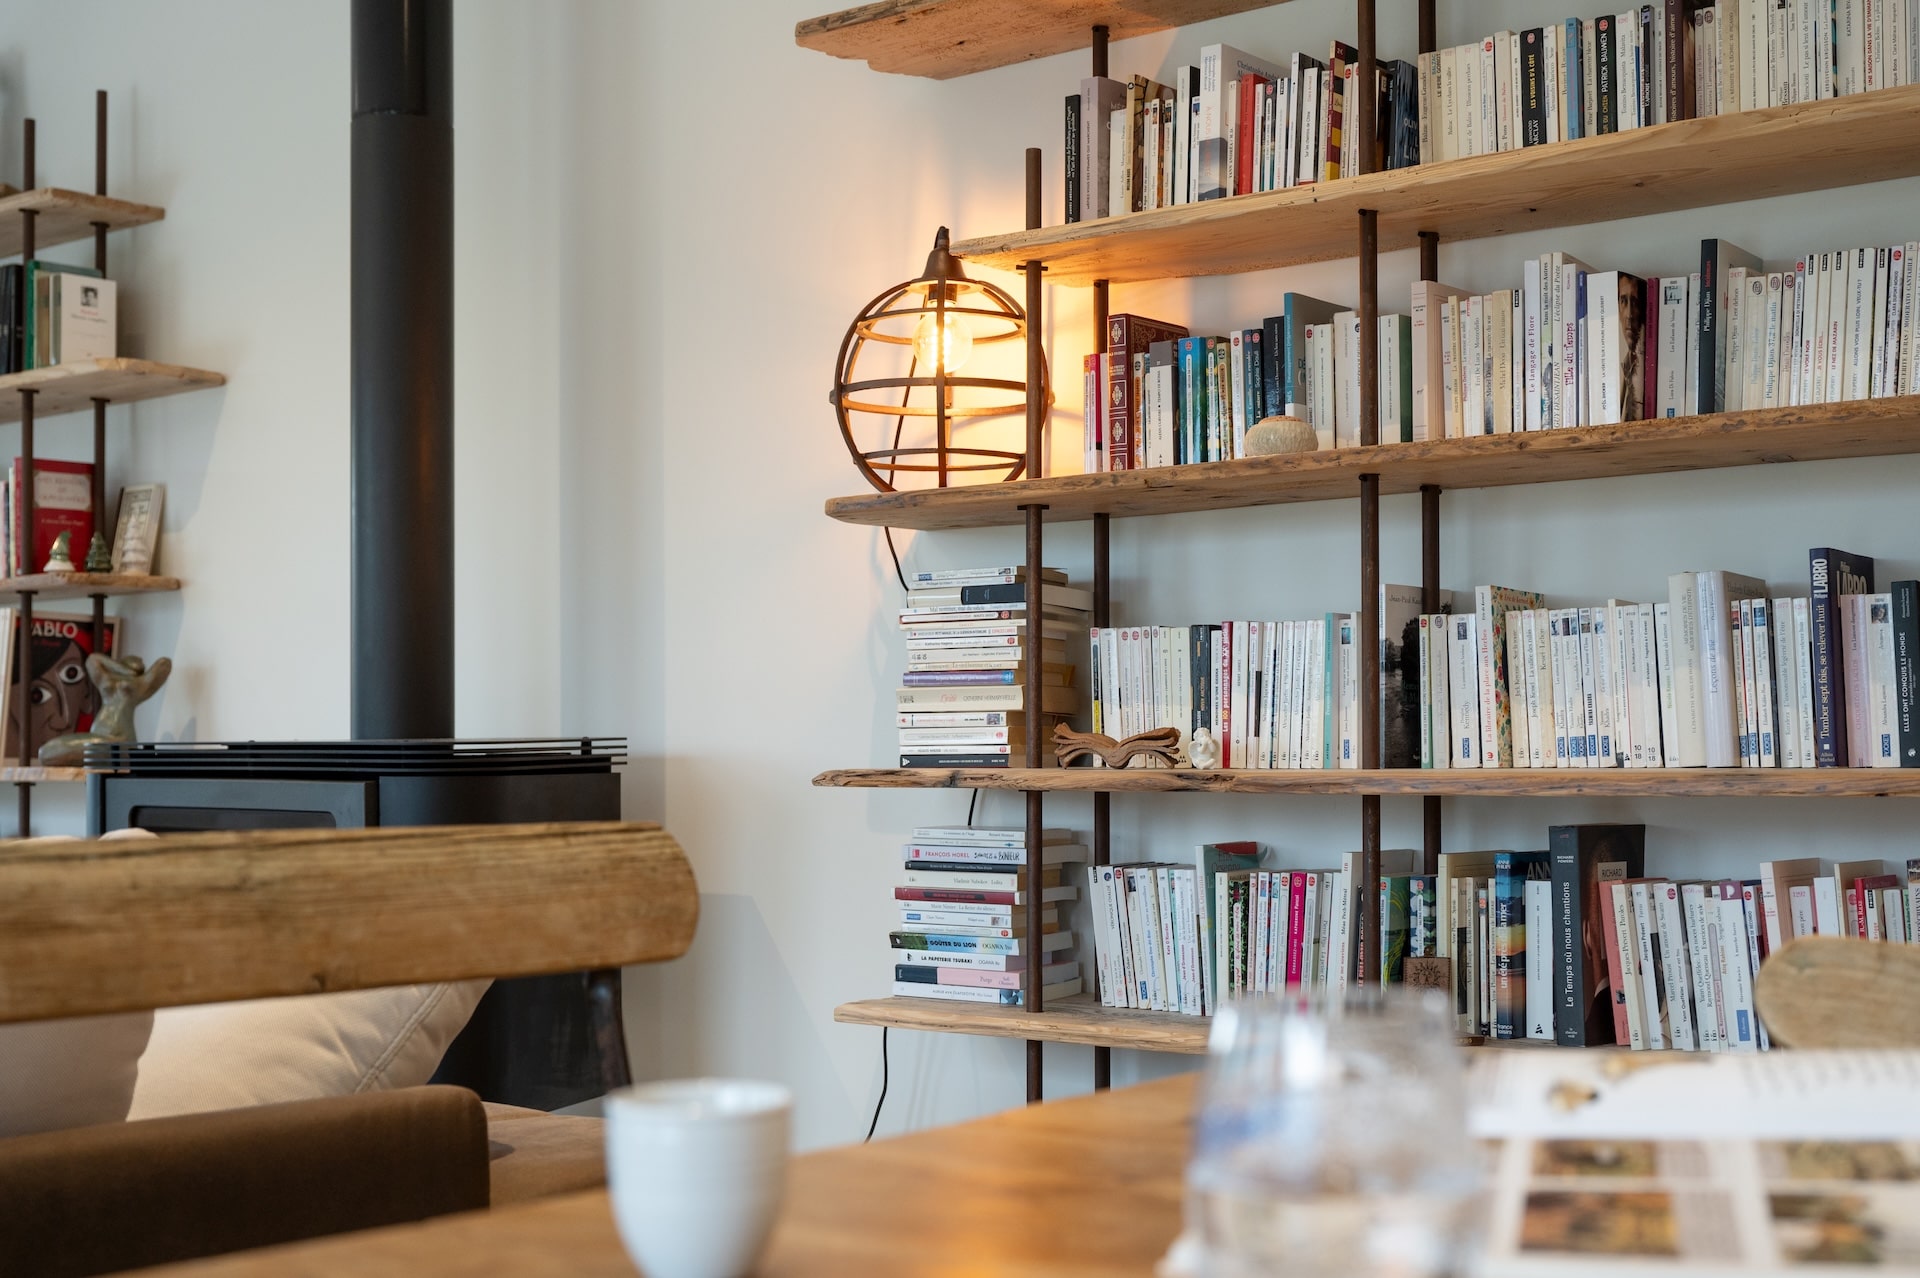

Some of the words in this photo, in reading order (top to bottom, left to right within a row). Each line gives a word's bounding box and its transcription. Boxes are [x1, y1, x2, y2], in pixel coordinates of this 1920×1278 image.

[1554, 284, 1560, 293] du
[1704, 308, 1712, 332] Philippe
[1529, 338, 1535, 347] de
[1564, 322, 1574, 349] Temps
[1565, 353, 1573, 363] du
[1565, 367, 1573, 385] Fille
[1529, 384, 1535, 392] Le
[1812, 558, 1828, 593] LABRO
[1816, 604, 1825, 622] huit
[32, 621, 78, 638] ABLO
[1817, 624, 1826, 654] relever
[1223, 659, 1228, 667] du
[1709, 652, 1716, 662] de
[1820, 655, 1827, 665] se
[1709, 664, 1718, 693] Leçons
[1818, 666, 1828, 684] fois,
[1484, 696, 1491, 705] de
[1819, 685, 1829, 703] sept
[1819, 705, 1830, 739] Tomber
[1485, 733, 1492, 743] La
[1602, 869, 1623, 878] RICHARD
[1561, 882, 1570, 925] chantions
[1564, 951, 1572, 963] où
[1664, 950, 1670, 958] Un
[1624, 952, 1632, 976] Jacques
[1501, 976, 1507, 988] un
[1564, 966, 1576, 994] Temps
[1565, 996, 1574, 1007] Le
[1705, 982, 1713, 1008] Raymond
